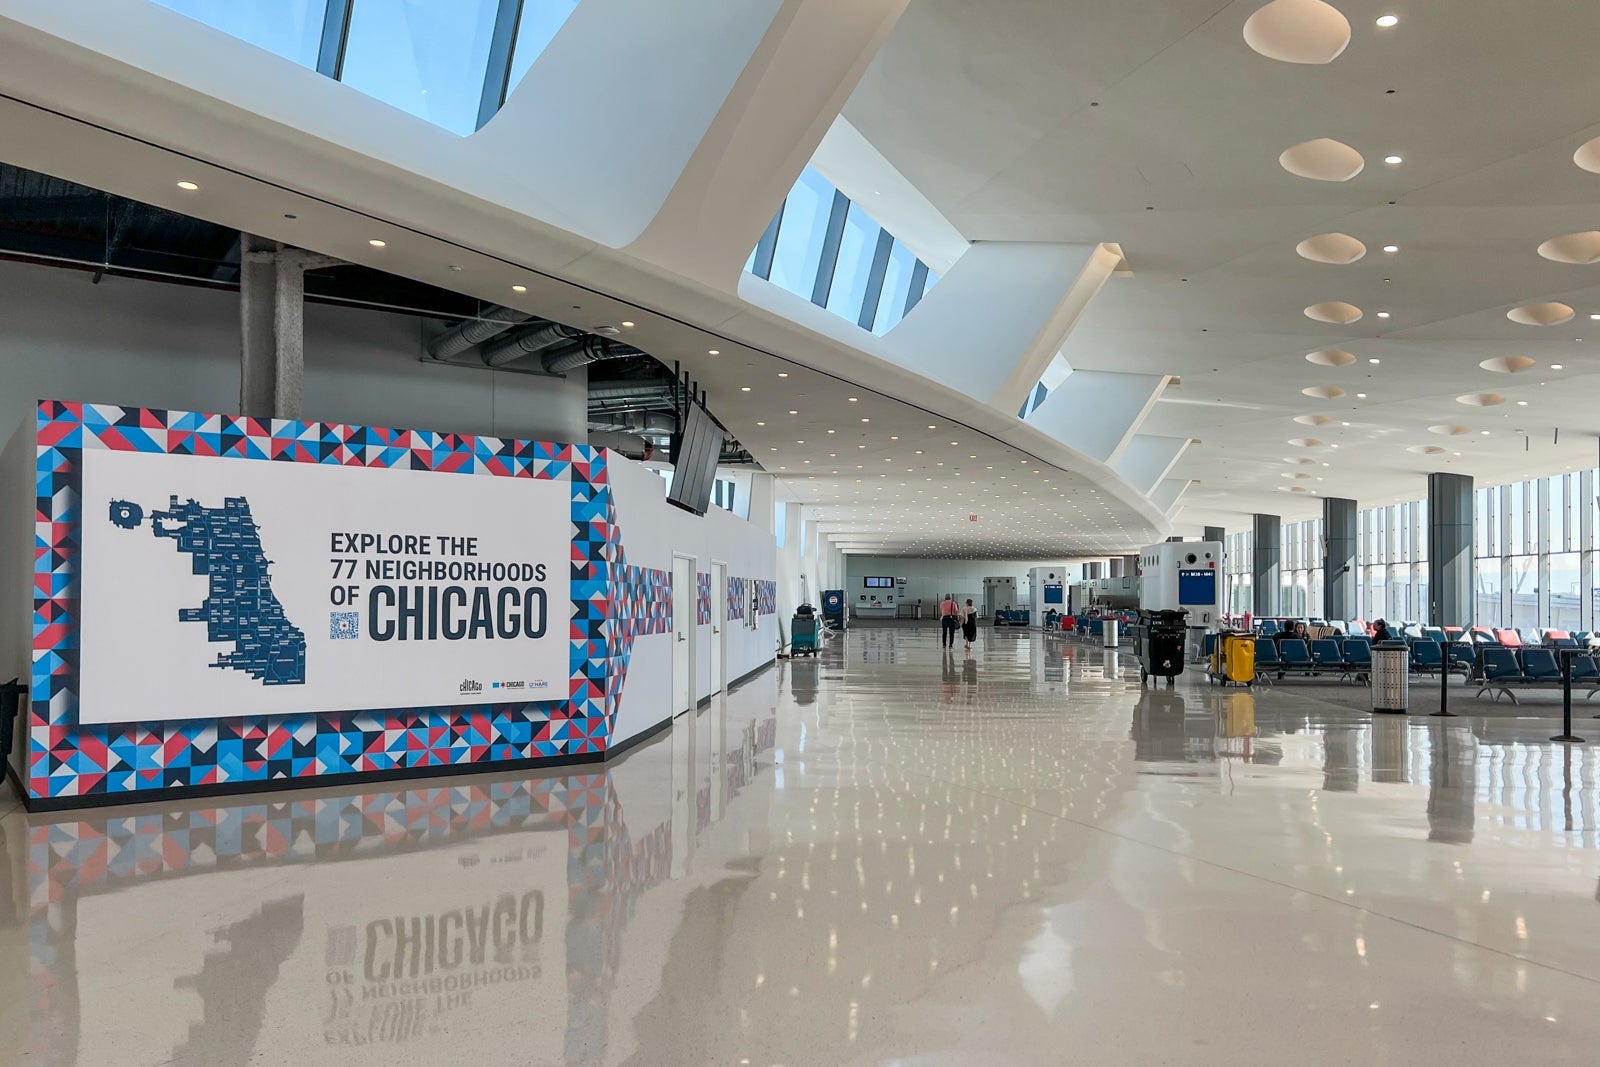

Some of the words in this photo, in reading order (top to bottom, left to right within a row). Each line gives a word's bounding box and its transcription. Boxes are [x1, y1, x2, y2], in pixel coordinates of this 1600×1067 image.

[331, 532, 431, 555] EXPLORE
[437, 536, 478, 556] THE
[330, 559, 358, 580] 77
[365, 559, 547, 582] NEIGHBORHOODS
[330, 585, 360, 606] OF
[368, 585, 548, 642] CHICAGO
[459, 678, 483, 692] CHICAGO
